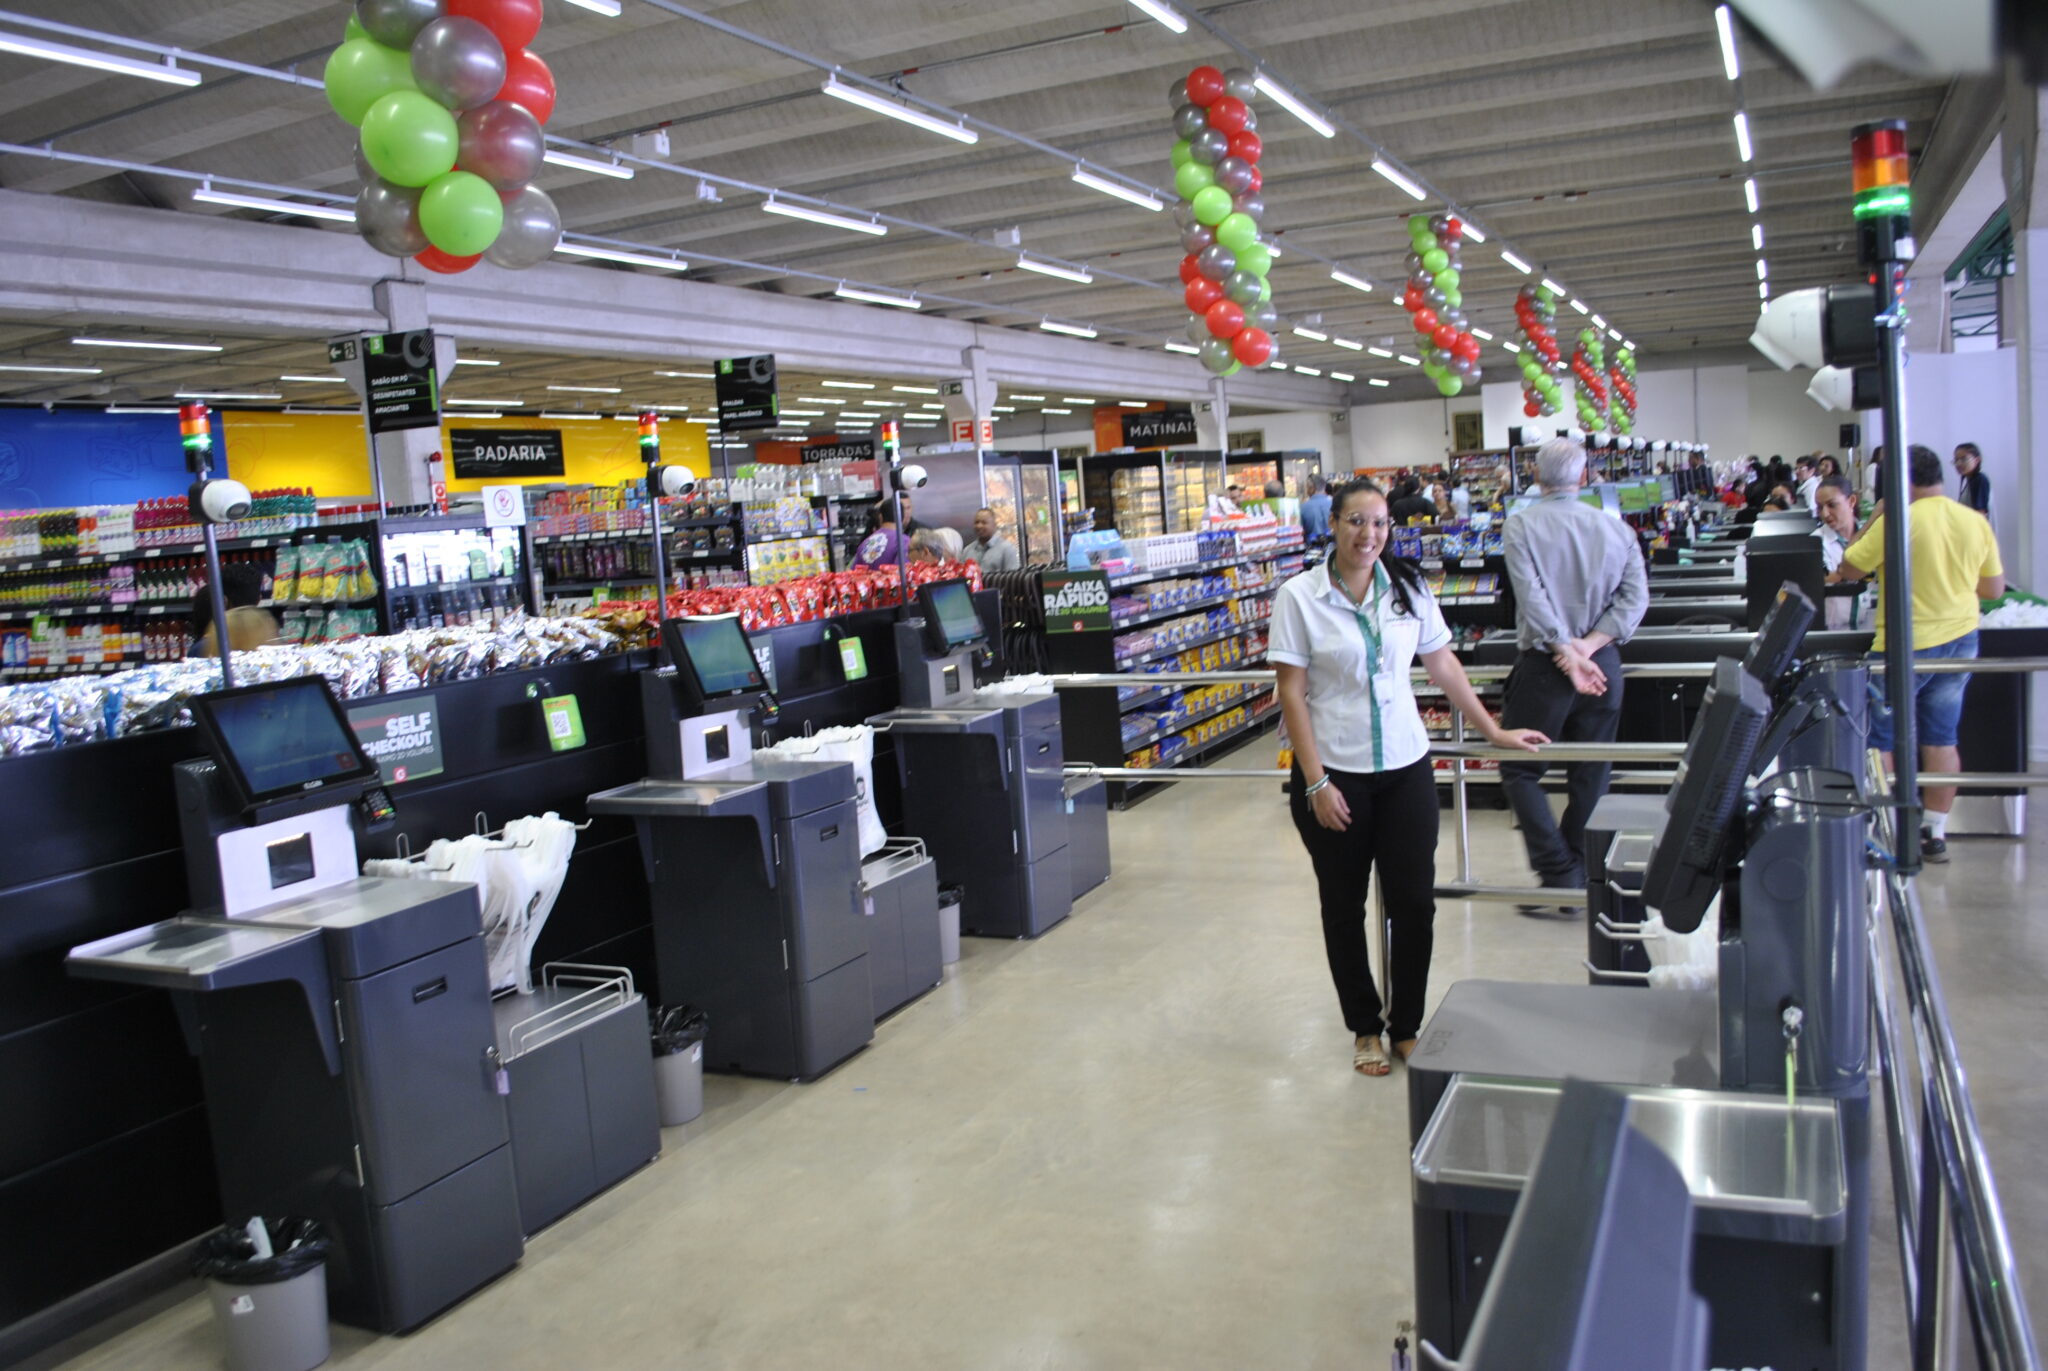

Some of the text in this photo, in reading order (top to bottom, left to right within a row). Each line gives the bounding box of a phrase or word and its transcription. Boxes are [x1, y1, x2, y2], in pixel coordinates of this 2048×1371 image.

[955, 422, 972, 441] E
[475, 446, 547, 461] PADARIA
[804, 445, 871, 461] TORRADAS
[1063, 580, 1105, 593] CAIXA
[1043, 589, 1109, 609] RÁPIDO
[1071, 605, 1109, 615] VOLUMES
[385, 712, 431, 738] SELF
[361, 730, 433, 757] CHECKOUT
